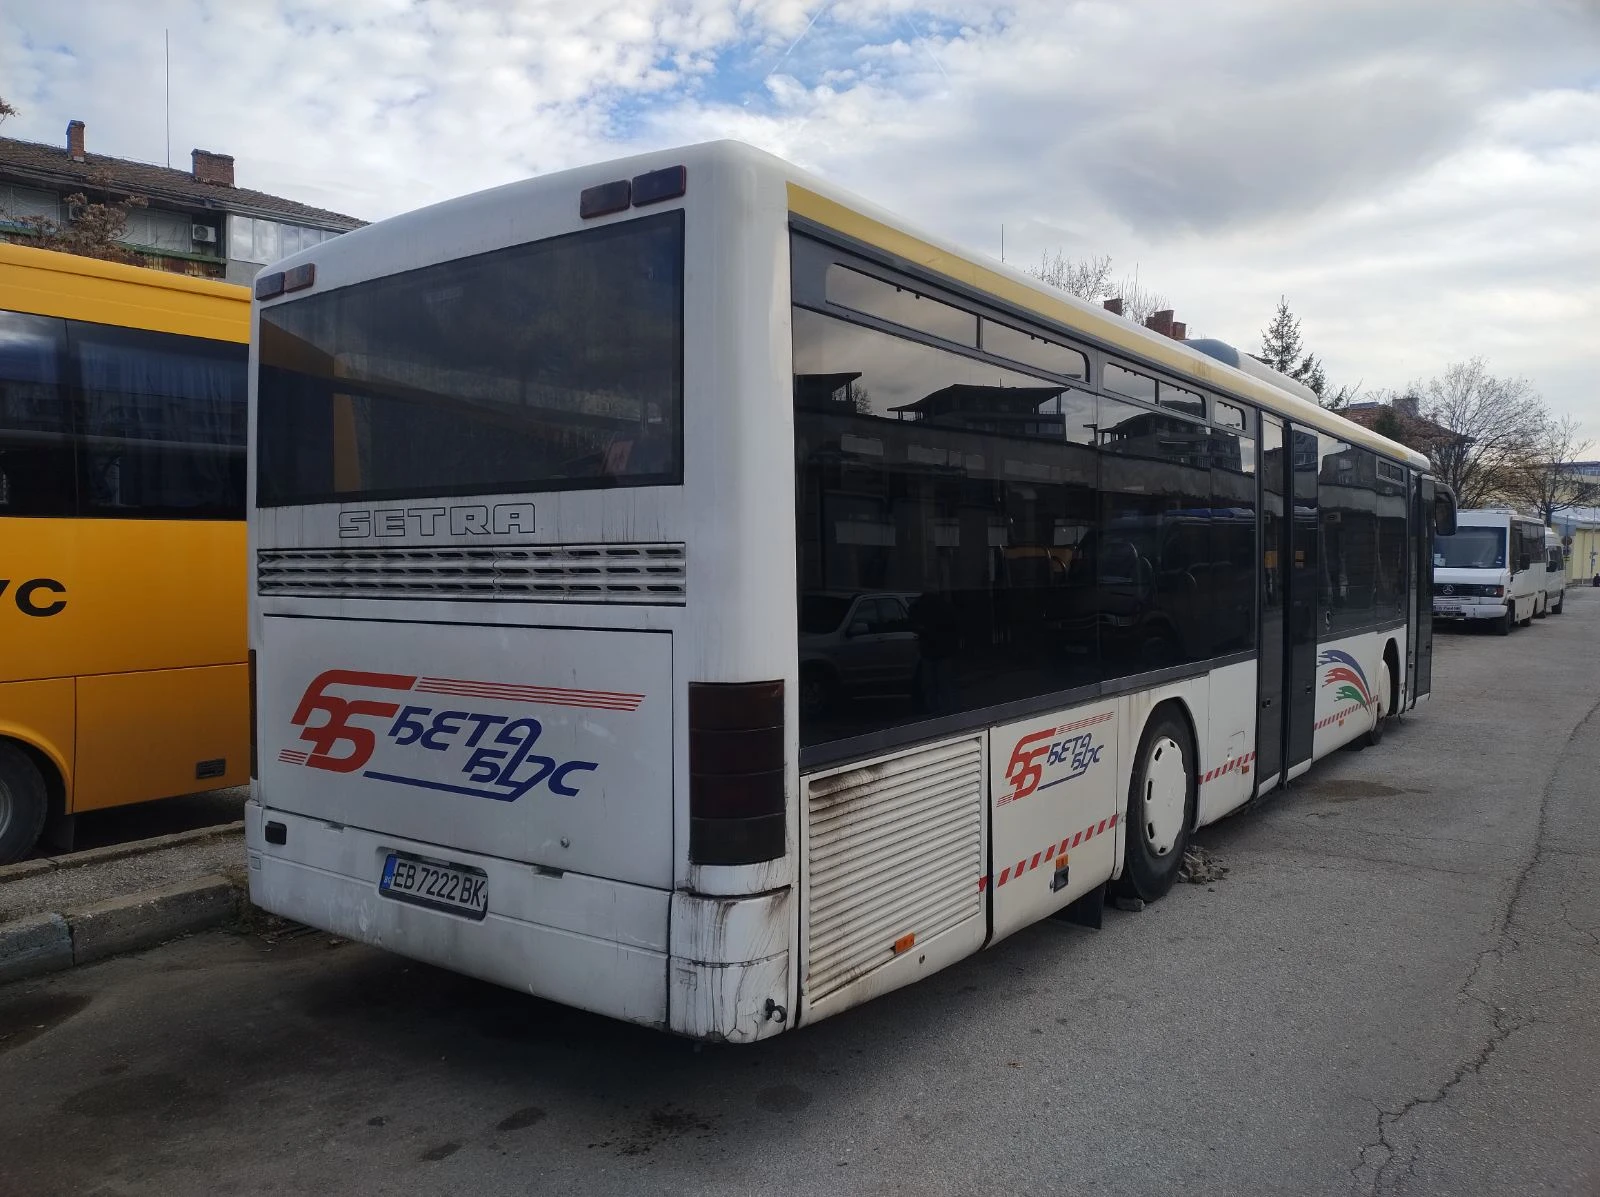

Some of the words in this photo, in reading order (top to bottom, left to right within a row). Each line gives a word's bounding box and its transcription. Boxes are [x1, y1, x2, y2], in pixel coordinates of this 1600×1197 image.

[338, 502, 536, 539] SETRA
[0, 578, 68, 618] С
[416, 867, 460, 901] 7222
